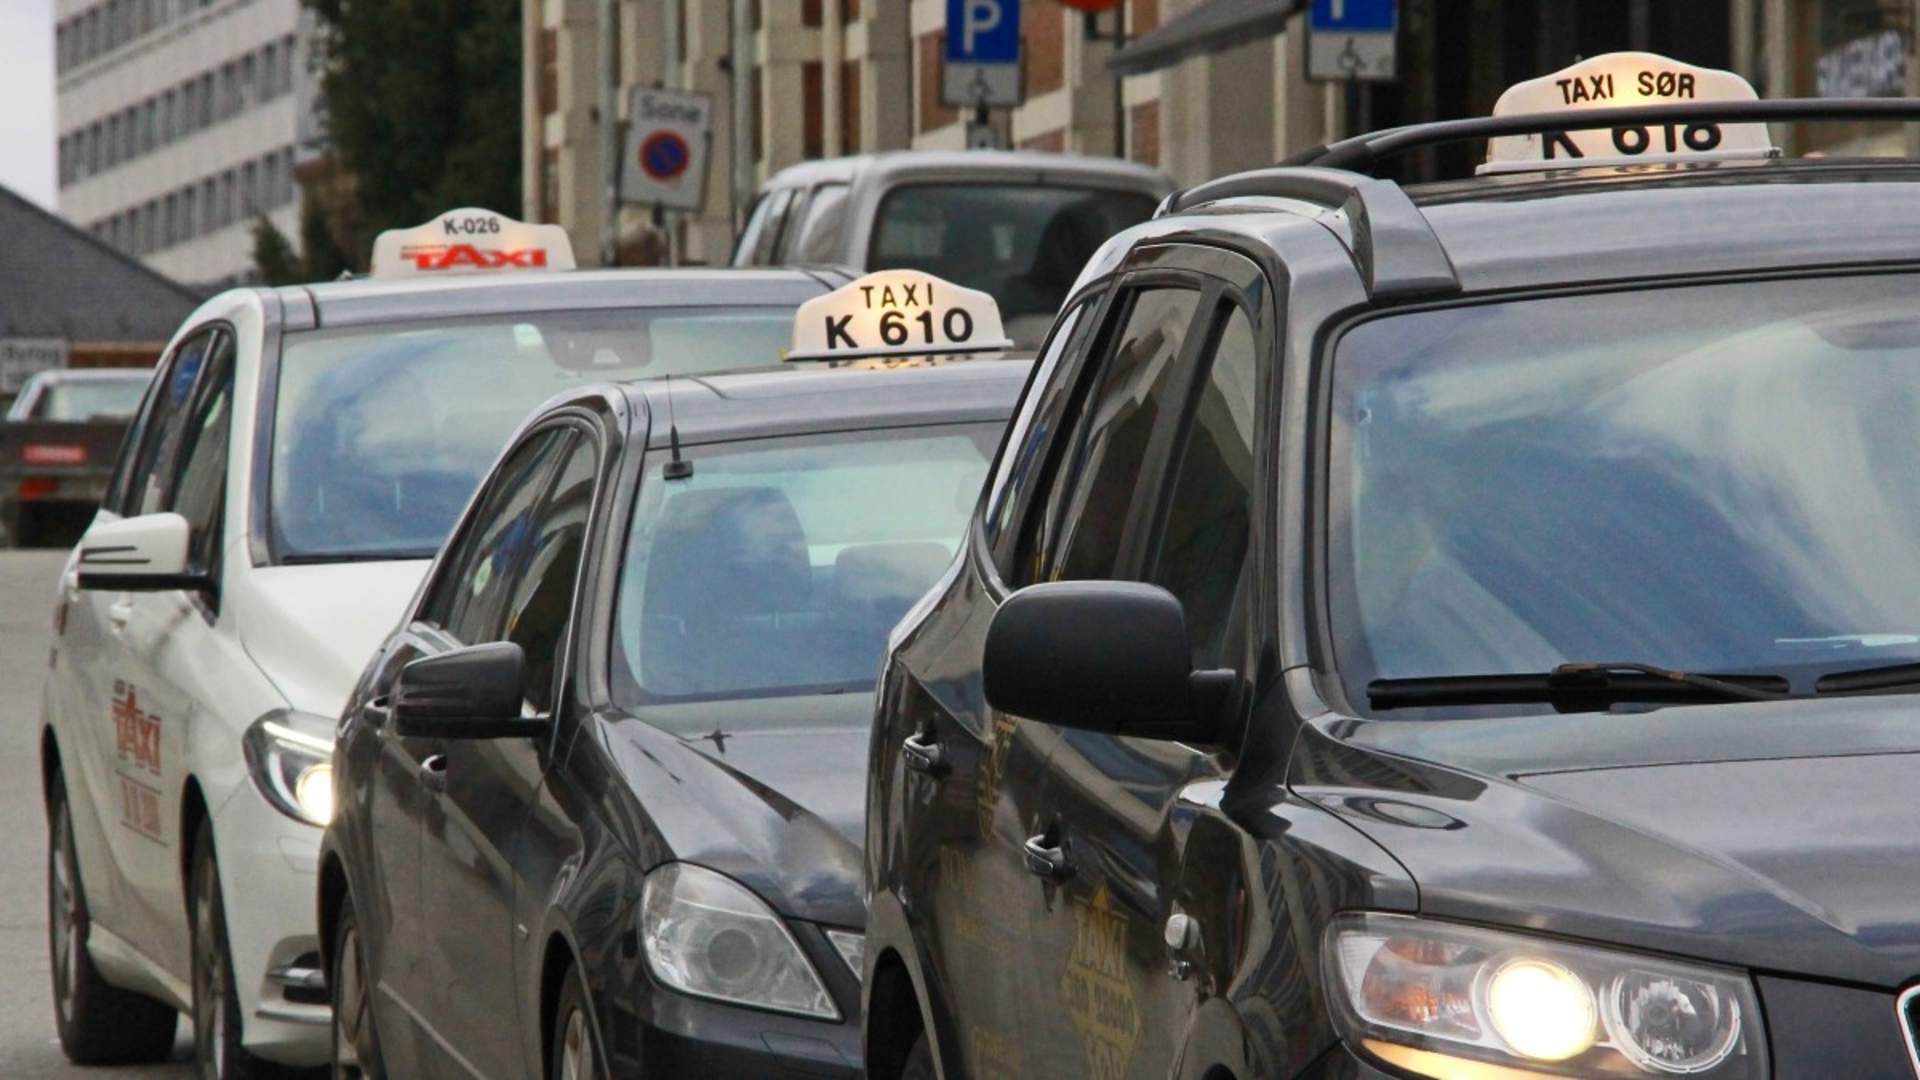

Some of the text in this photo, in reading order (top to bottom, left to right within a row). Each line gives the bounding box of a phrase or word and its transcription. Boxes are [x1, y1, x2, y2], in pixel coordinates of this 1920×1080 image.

[963, 0, 1001, 53] P
[1556, 71, 1695, 104] TAXI SØR
[443, 217, 500, 235] K-026
[401, 244, 546, 270] TAXI
[860, 283, 933, 309] TAXI
[825, 307, 973, 349] K 610
